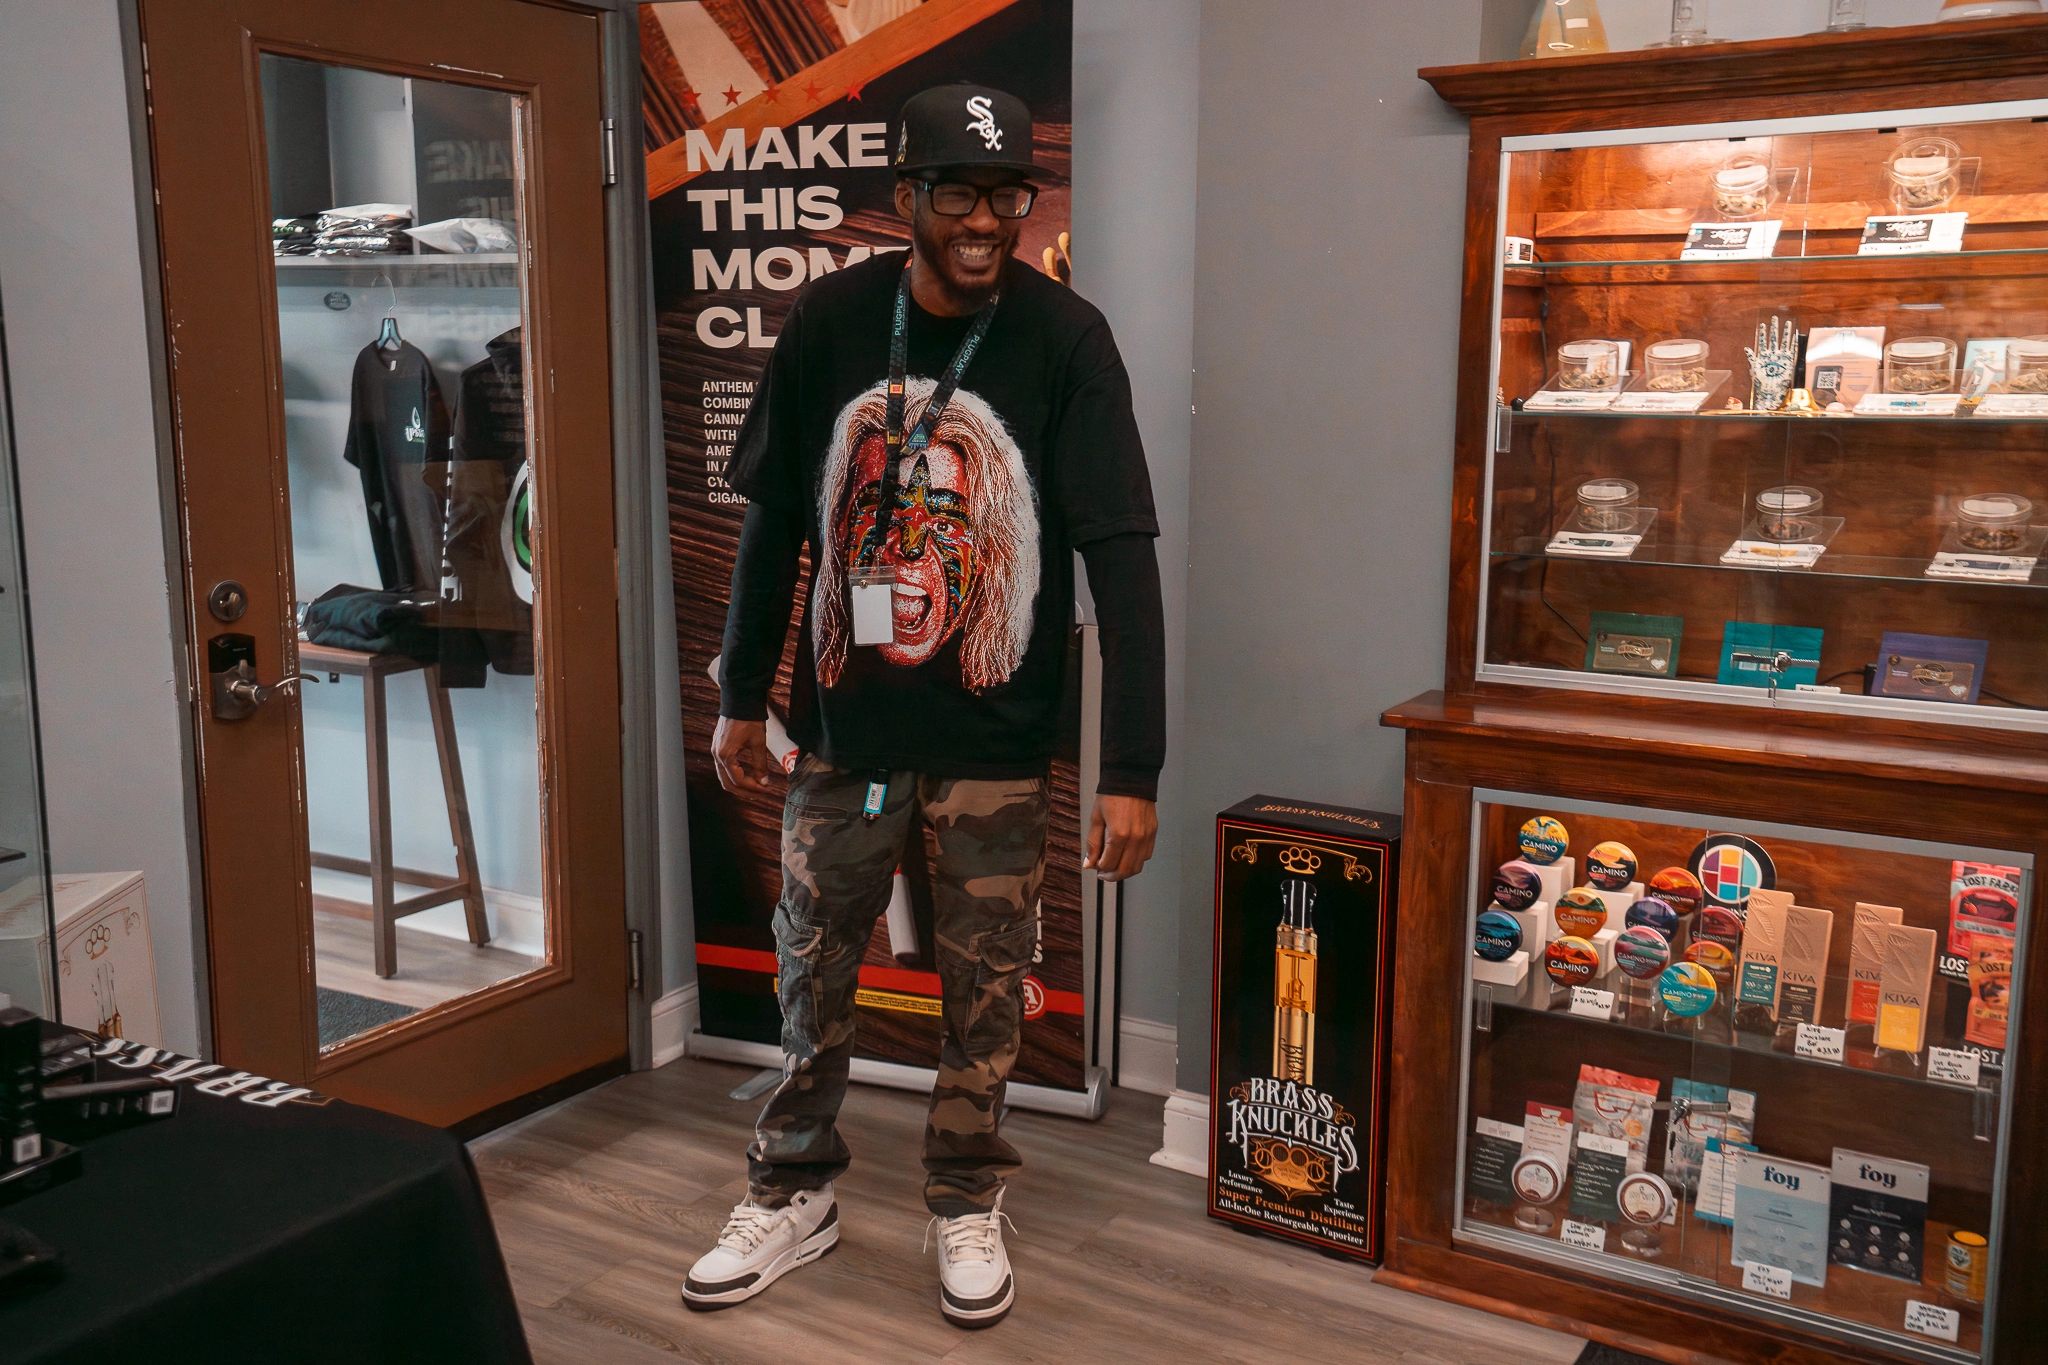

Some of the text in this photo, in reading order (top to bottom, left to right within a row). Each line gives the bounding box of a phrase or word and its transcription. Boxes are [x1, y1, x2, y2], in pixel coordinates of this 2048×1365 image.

[685, 123, 888, 172] MAKE
[687, 186, 844, 231] THIS
[692, 246, 912, 291] MOM
[696, 306, 778, 349] CL
[703, 397, 752, 409] COMBIN
[704, 429, 737, 441] WITH
[706, 445, 734, 456] AME
[707, 461, 719, 472] IN
[708, 492, 750, 504] CIGAR
[1523, 839, 1558, 853] CAMINO
[1591, 865, 1628, 878] CAMINO
[1496, 885, 1533, 898] CAMINO
[1651, 891, 1681, 902] CAMINO
[1560, 913, 1598, 925] CAMINO
[1475, 935, 1512, 948] CAMINO
[1617, 952, 1646, 963] CAMINO
[1745, 951, 1777, 963] KIVA
[1550, 960, 1589, 974] CAMINO
[1979, 962, 2005, 973] LOST
[1783, 971, 1816, 984] KIVA
[1855, 969, 1881, 980] KIV
[1662, 988, 1692, 998] CAMINO
[1885, 993, 1920, 1006] KIVA
[1250, 1077, 1335, 1120] BRASS
[1226, 1099, 1360, 1172] KNUCKLES
[1228, 1170, 1254, 1184] Luxury
[1763, 1165, 1800, 1191] foy
[1859, 1163, 1897, 1189] foy
[1219, 1176, 1263, 1194] Performance
[1219, 1186, 1364, 1234] Super Premium Distillate
[1333, 1198, 1355, 1210] Taste
[1324, 1204, 1365, 1222] Experience
[1219, 1198, 1364, 1245] All-In-One Rechargeable Vaporizer
